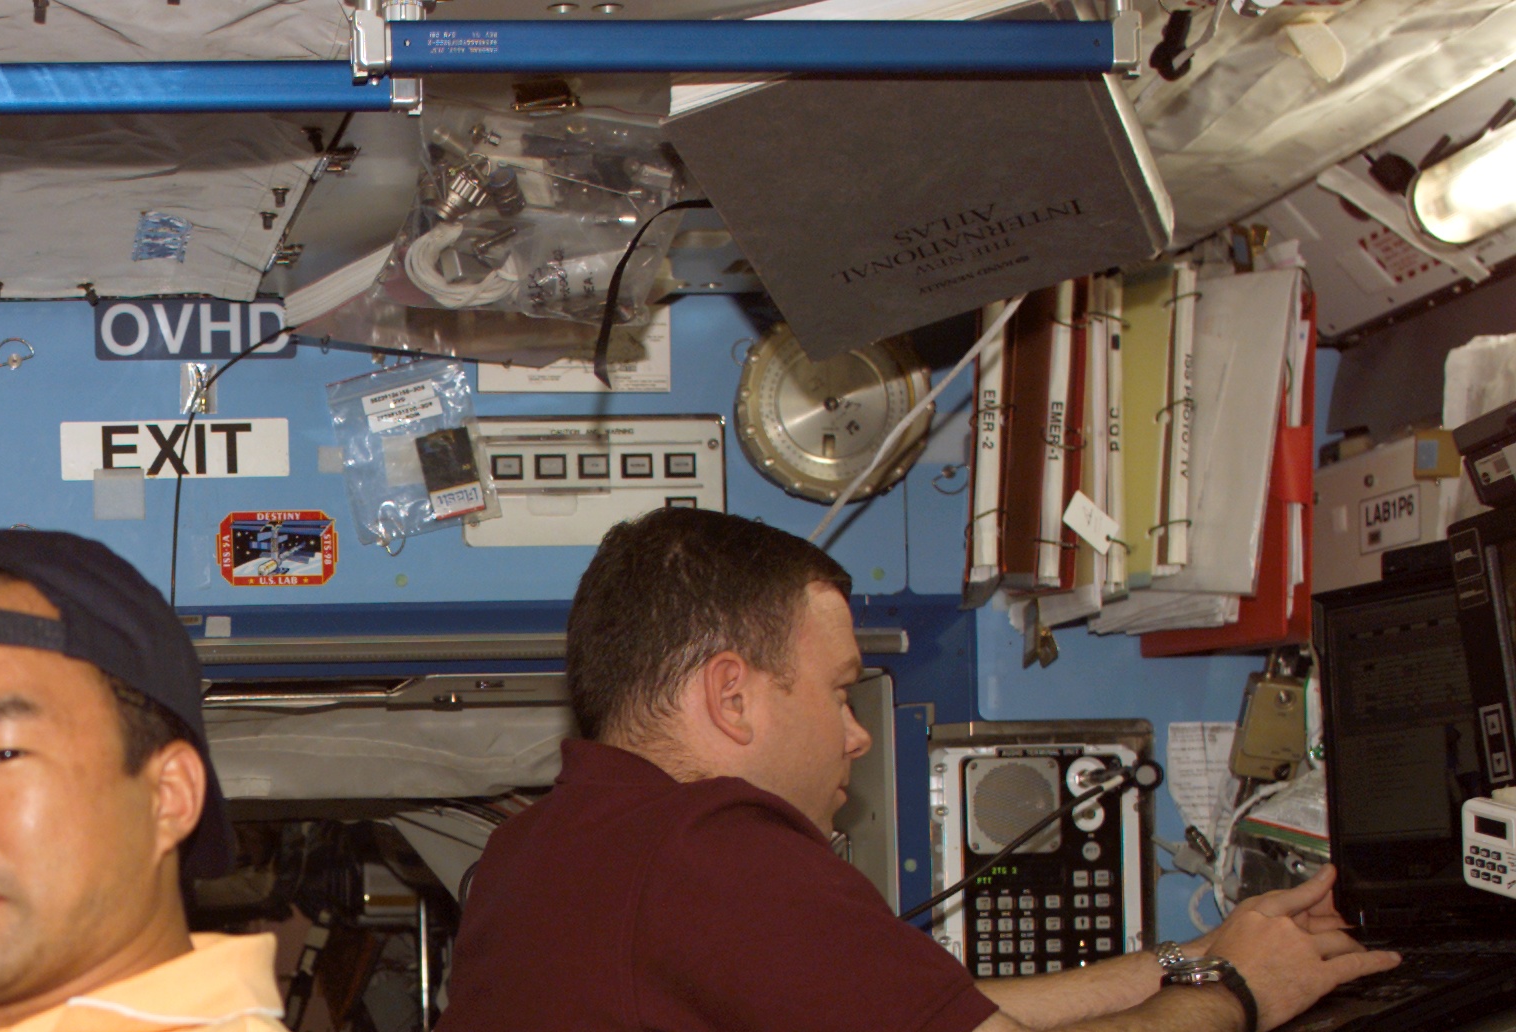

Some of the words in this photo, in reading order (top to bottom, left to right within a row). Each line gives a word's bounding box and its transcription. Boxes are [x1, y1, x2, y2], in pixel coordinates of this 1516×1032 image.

[831, 199, 1083, 284] INTERNATIONAL
[893, 203, 995, 245] ATLAS
[100, 302, 291, 357] OVHD
[101, 422, 253, 476] EXIT
[256, 511, 302, 521] DESTINY
[258, 576, 277, 585] U.S.
[278, 576, 299, 585] LAB
